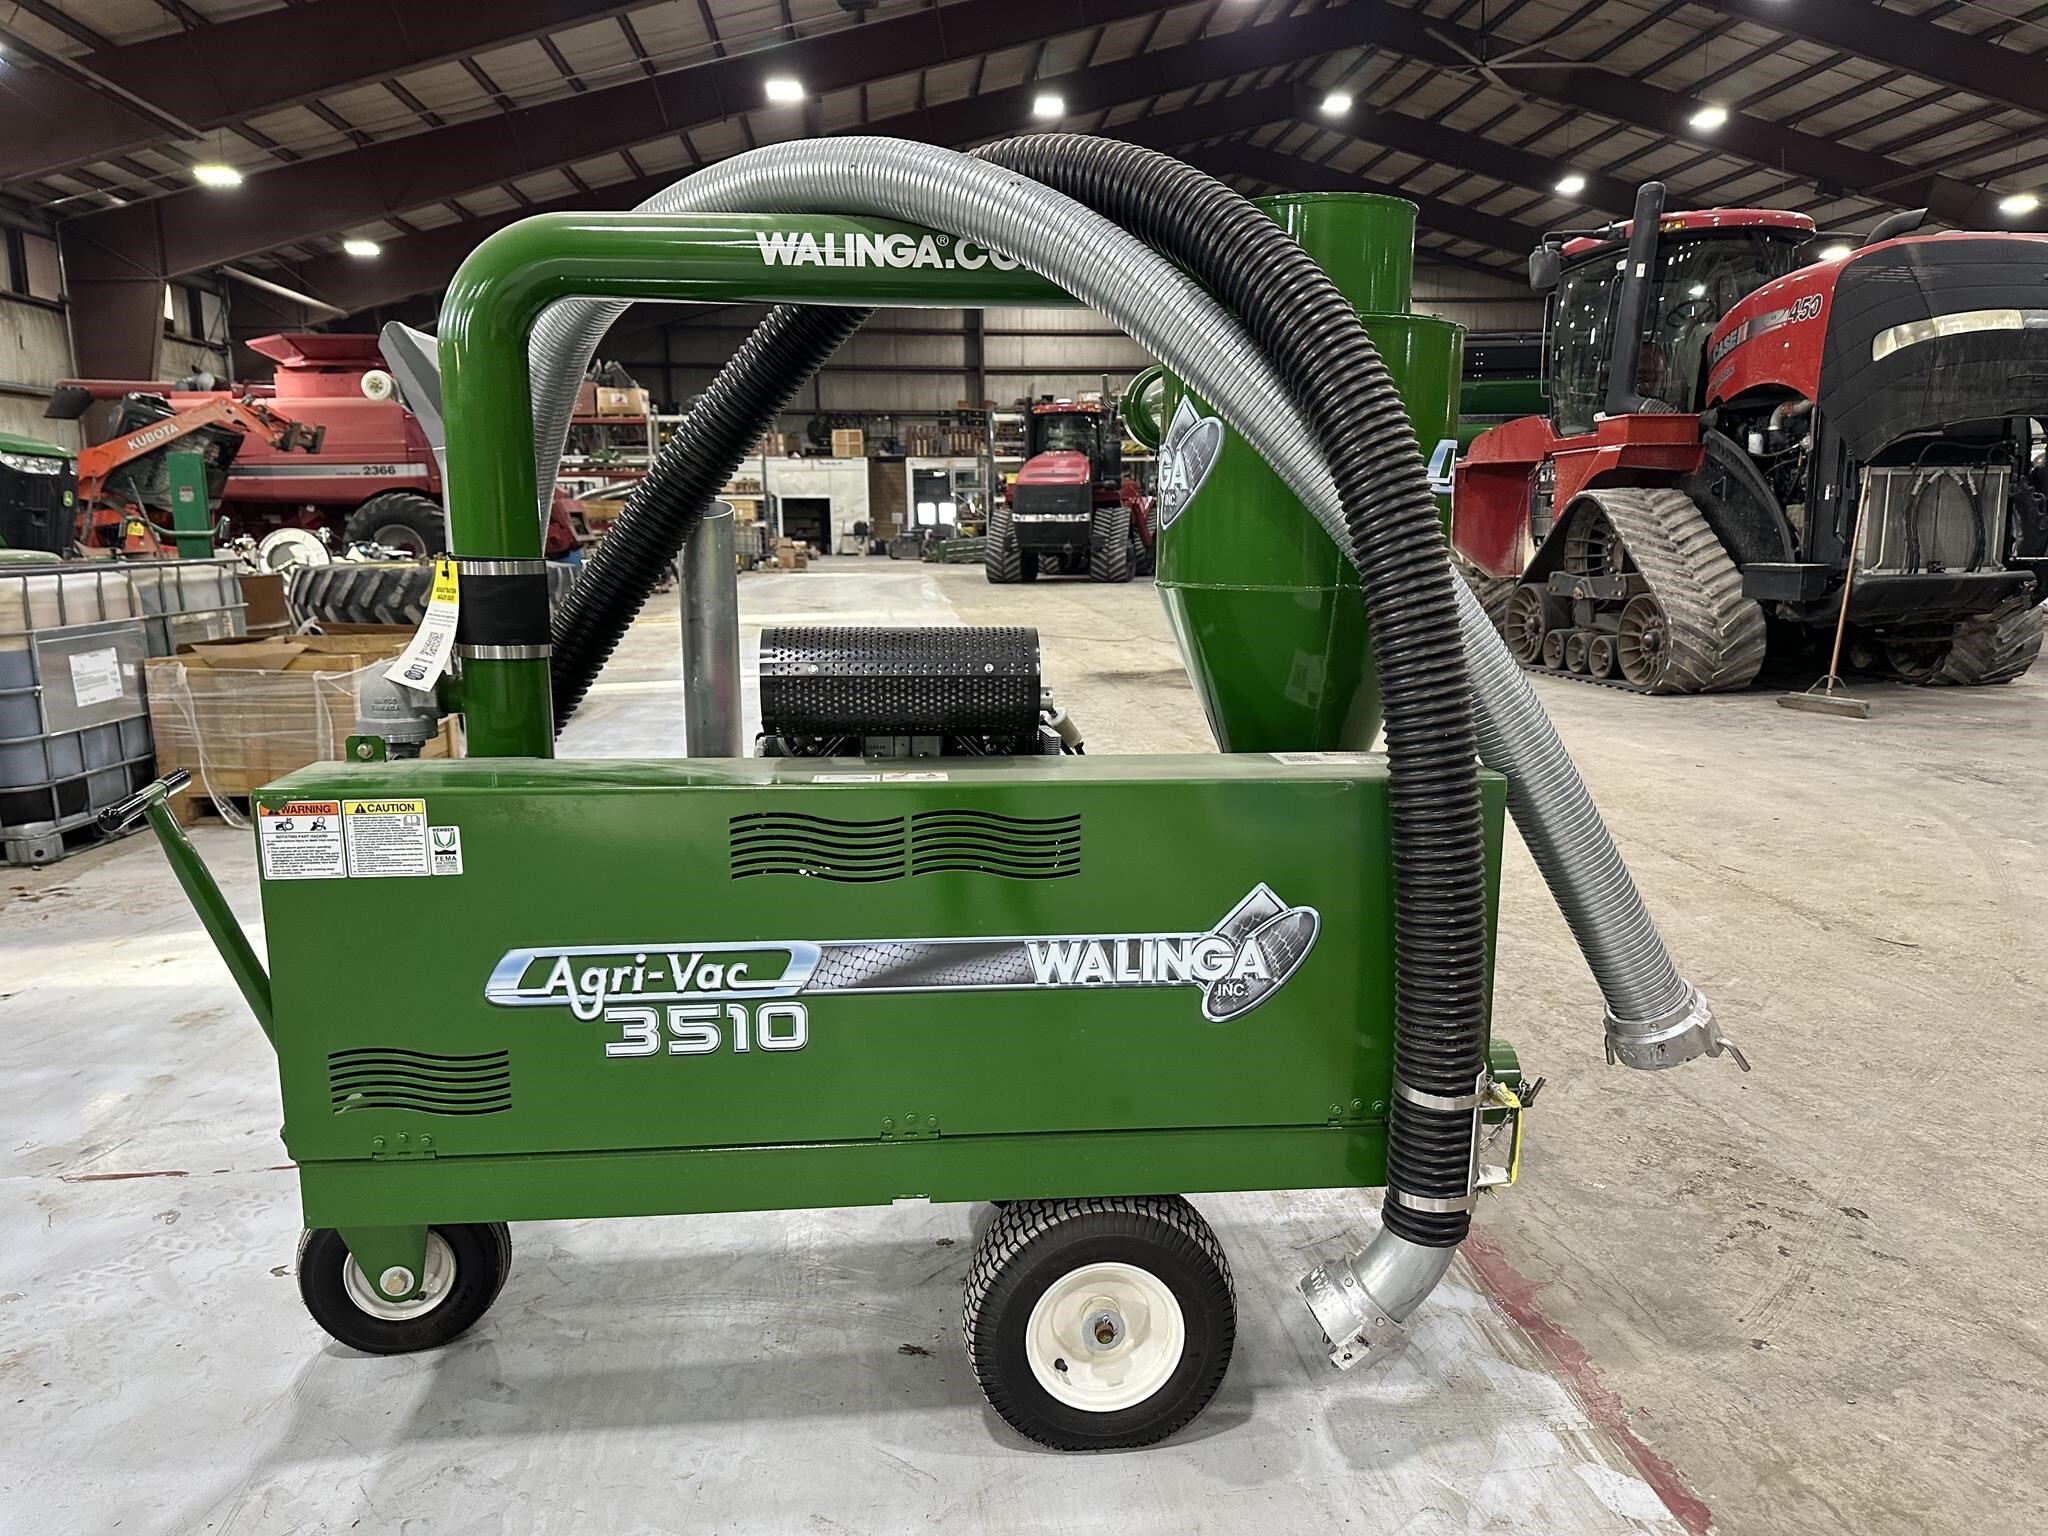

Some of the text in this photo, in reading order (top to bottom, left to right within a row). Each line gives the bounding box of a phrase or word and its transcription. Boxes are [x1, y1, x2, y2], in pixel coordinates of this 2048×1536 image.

[756, 231, 1034, 271] WALINGA®.CO
[1788, 293, 1823, 323] 450
[1713, 328, 1739, 363] CASE
[127, 423, 180, 450] KUBOTA
[362, 465, 397, 476] 2366
[281, 804, 331, 814] WARNING
[367, 803, 415, 812] CAUTION
[1025, 936, 1272, 984] WALINGA
[546, 953, 749, 1021] Agri-Vac
[1217, 983, 1249, 997] INC.
[604, 1001, 809, 1058] 3510
